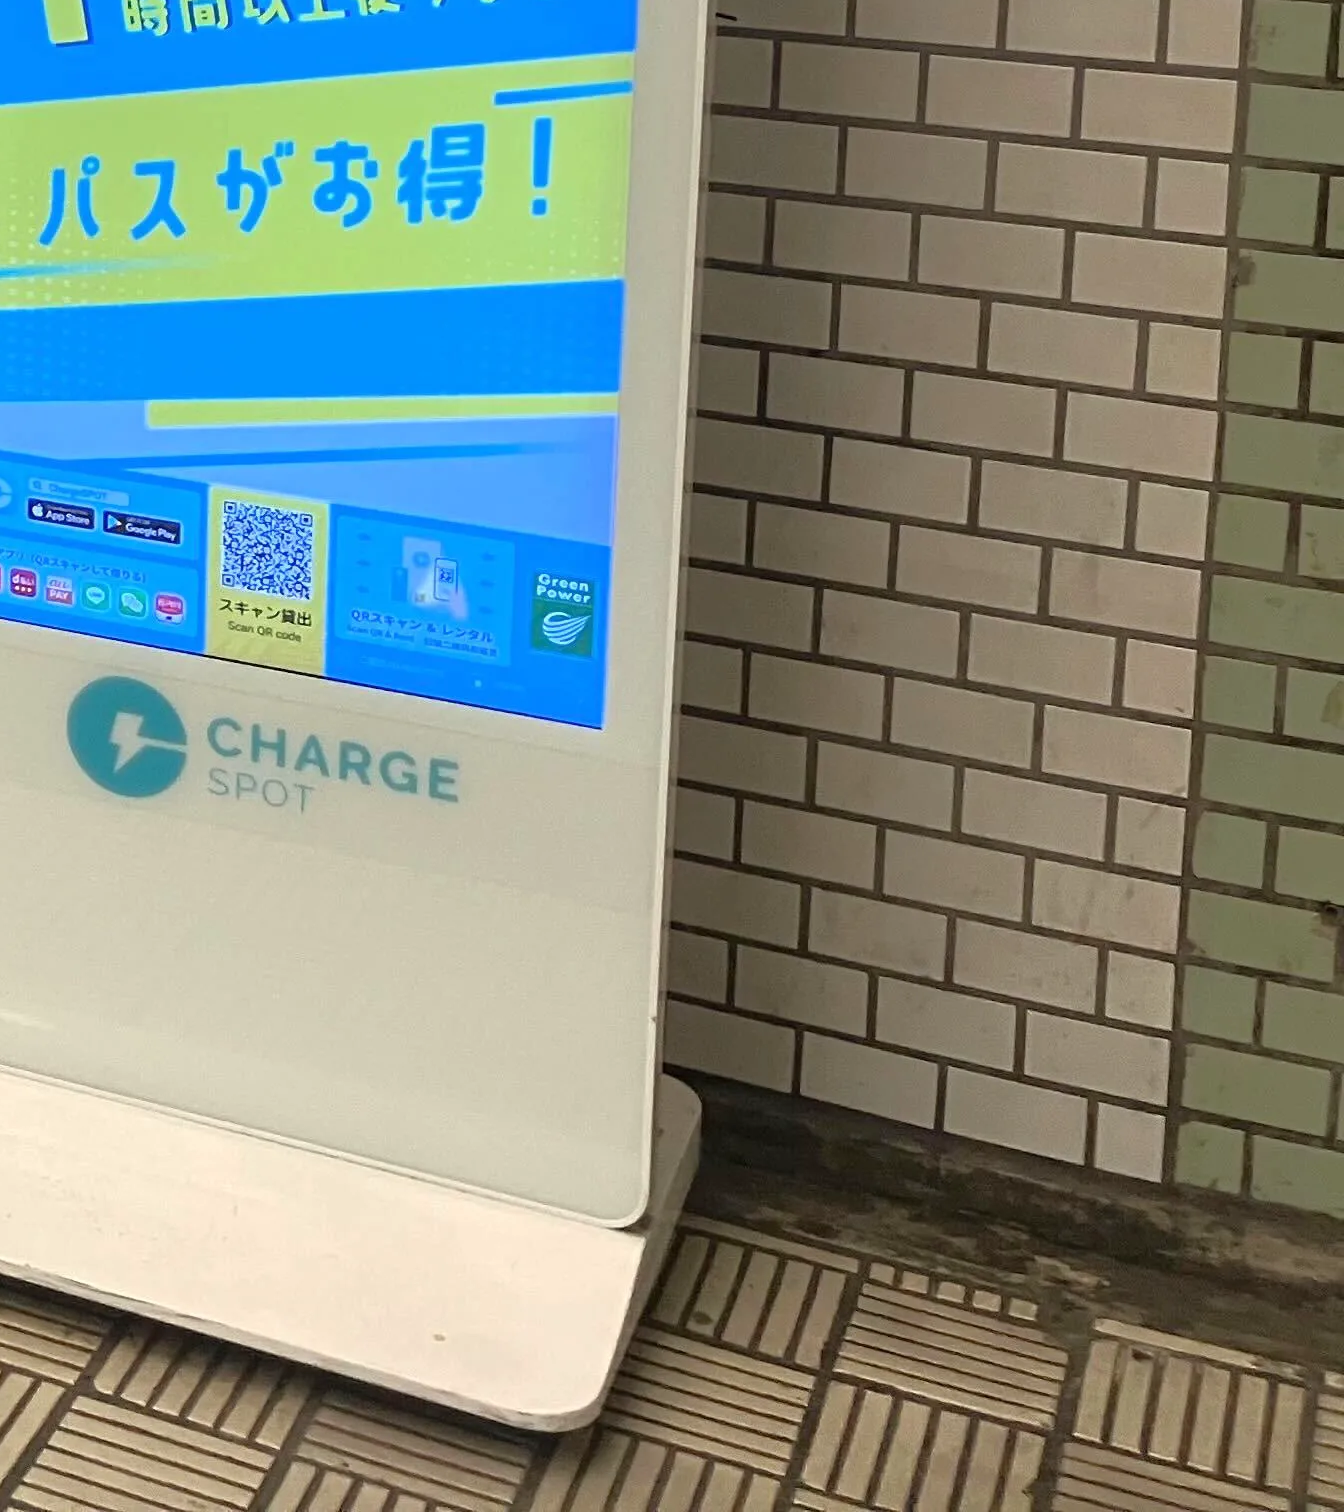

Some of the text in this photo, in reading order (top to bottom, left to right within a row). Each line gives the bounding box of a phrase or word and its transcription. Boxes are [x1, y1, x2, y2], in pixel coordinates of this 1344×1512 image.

[45, 511, 90, 525] App Store
[125, 523, 176, 541] Google Play
[538, 573, 589, 592] Green
[536, 586, 591, 605] Power
[219, 598, 312, 627] スキャン貸出
[228, 621, 301, 642] Scan QR code
[207, 717, 459, 803] CHARGE
[207, 769, 315, 814] SPOT
